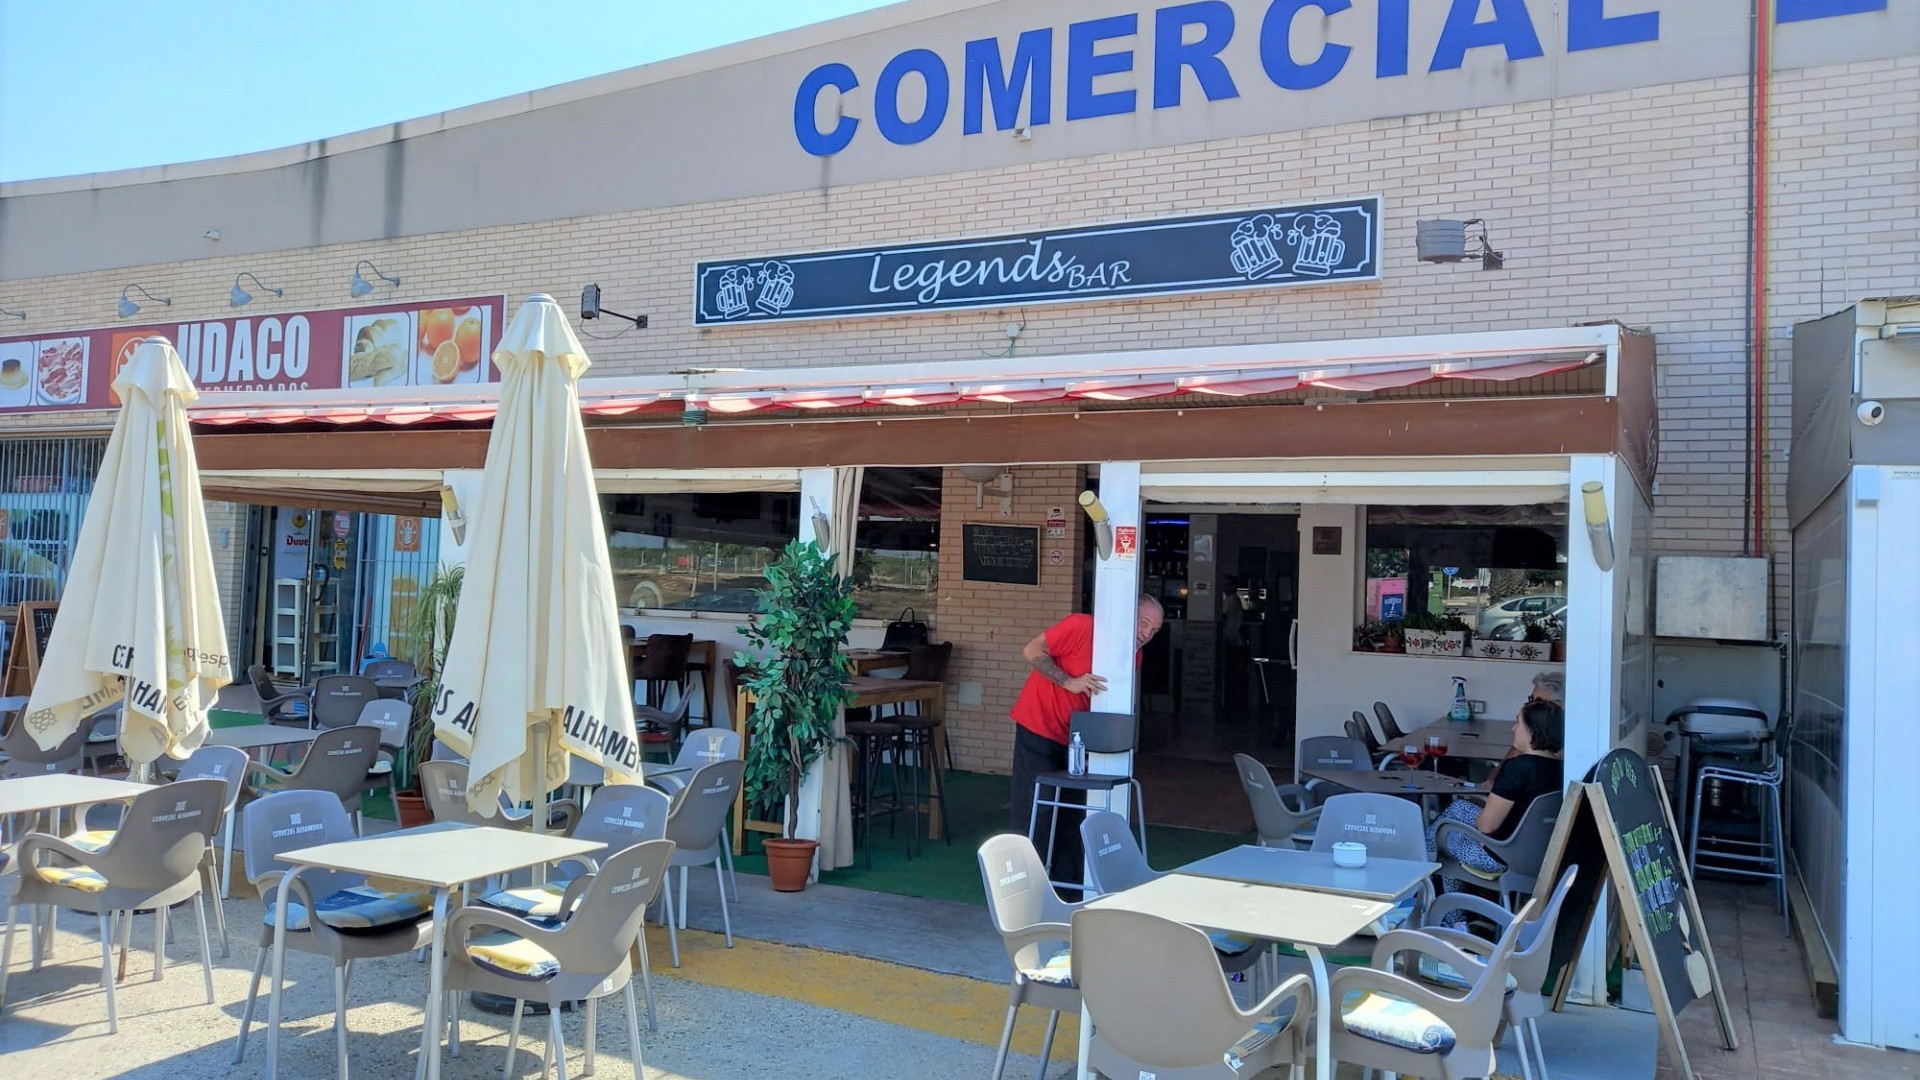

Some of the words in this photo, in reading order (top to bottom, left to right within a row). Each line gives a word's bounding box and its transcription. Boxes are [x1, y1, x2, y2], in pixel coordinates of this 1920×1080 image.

[794, 0, 1660, 157] COMERCIAL
[868, 239, 1076, 303] Legends
[1067, 260, 1132, 288] BAR
[286, 534, 310, 547] Duve
[563, 704, 640, 774] ALHAMB
